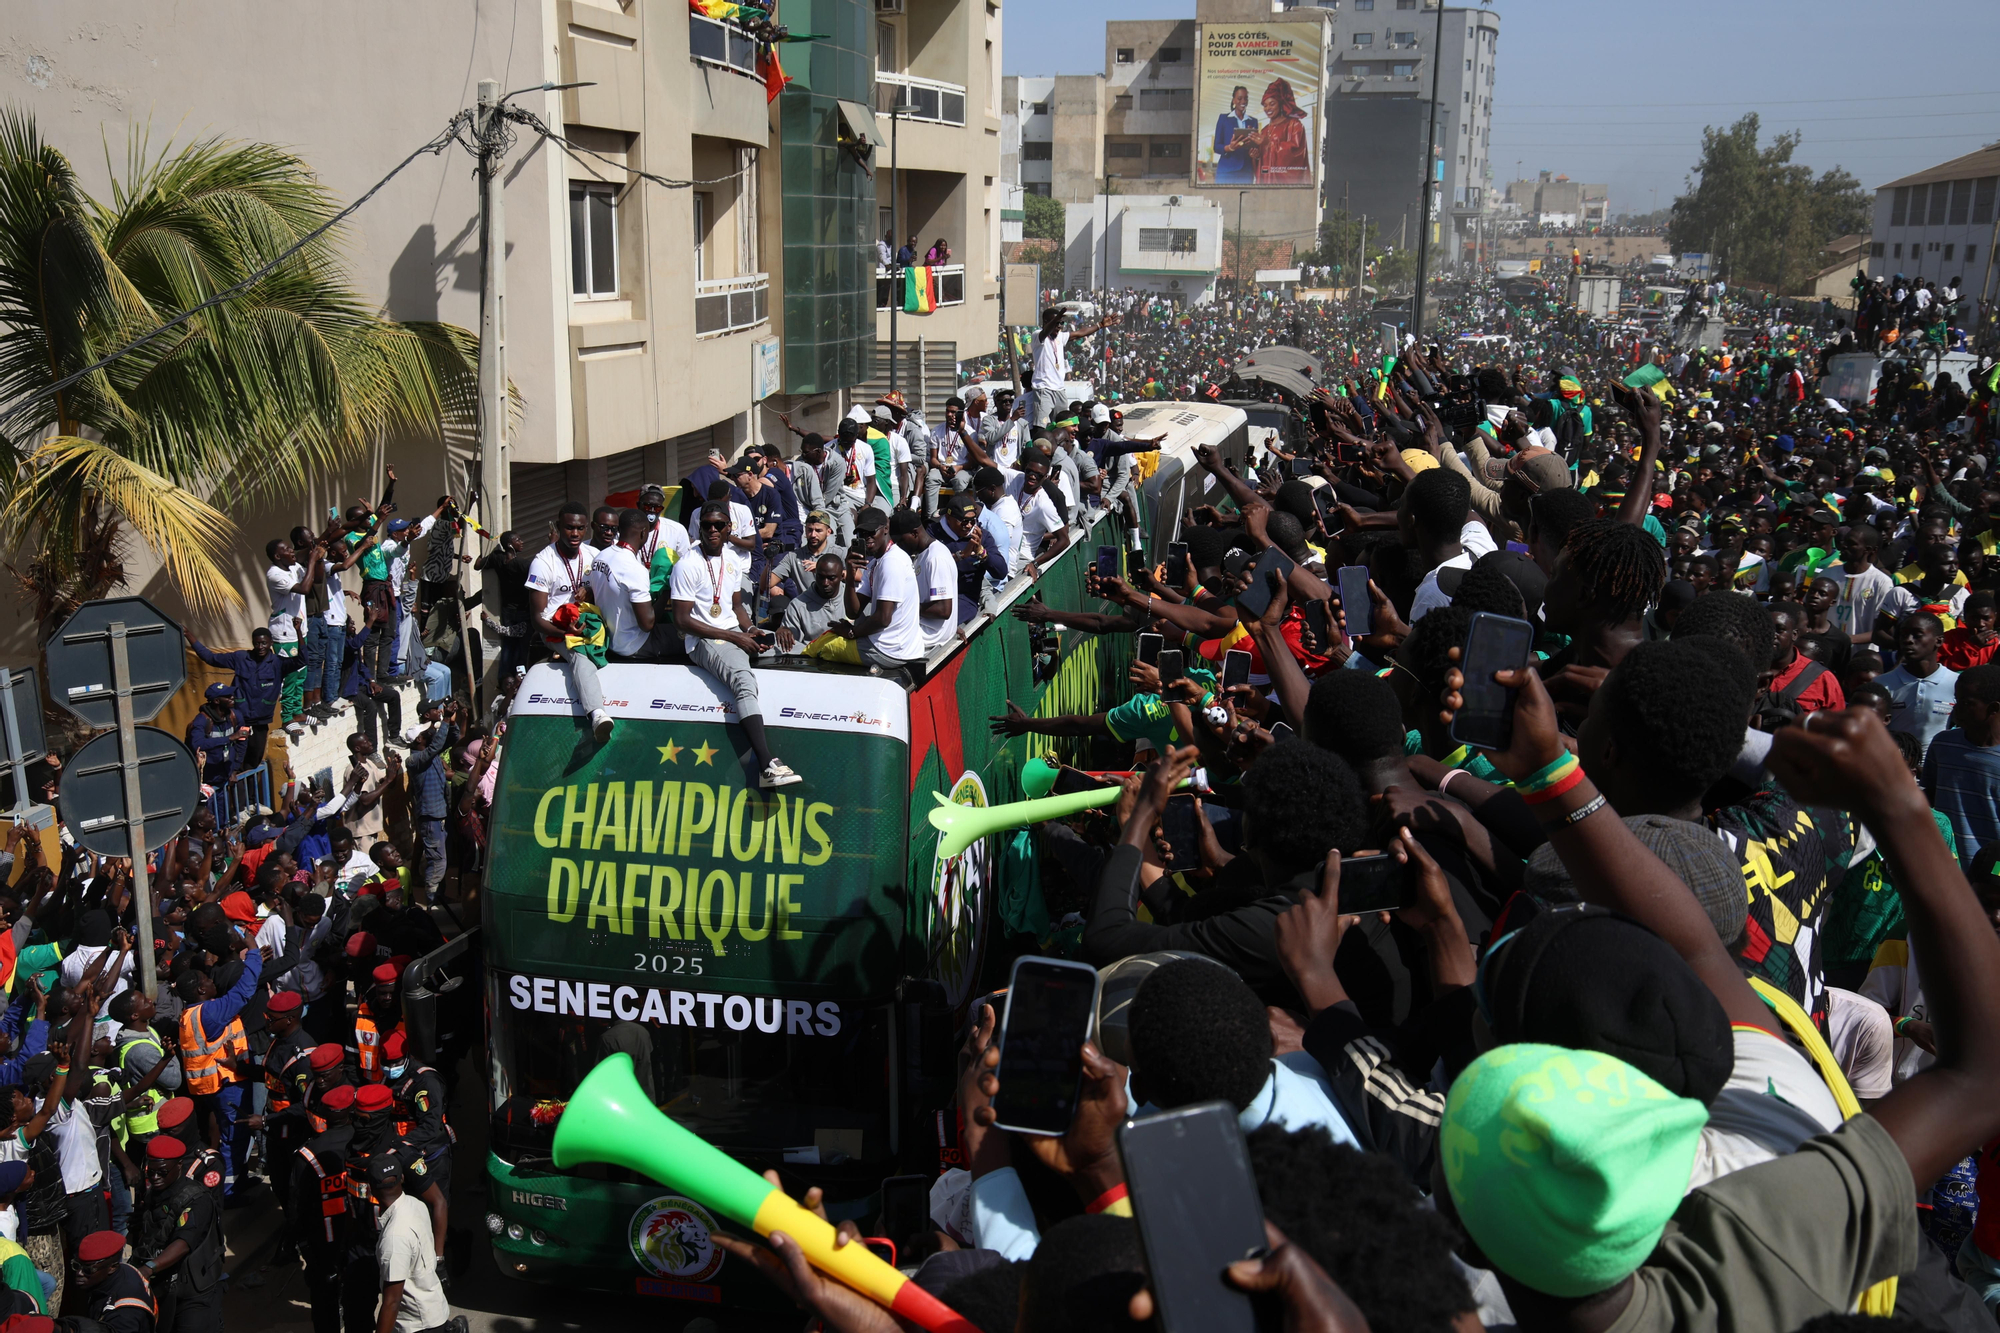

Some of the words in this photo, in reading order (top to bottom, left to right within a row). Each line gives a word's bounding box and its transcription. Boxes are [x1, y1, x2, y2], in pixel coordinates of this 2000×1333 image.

[1208, 31, 1215, 40] À
[1238, 31, 1270, 40] CÔTÉS,
[1836, 604, 1853, 621] 97
[527, 693, 630, 708] SENECAURS
[533, 780, 834, 866] CHAMPIONS
[1863, 860, 1883, 892] 25
[547, 857, 805, 957] D'AFRIQUE
[633, 953, 704, 976] 2025
[509, 975, 841, 1036] SENECARTOURS
[512, 1190, 567, 1211] HIGER
